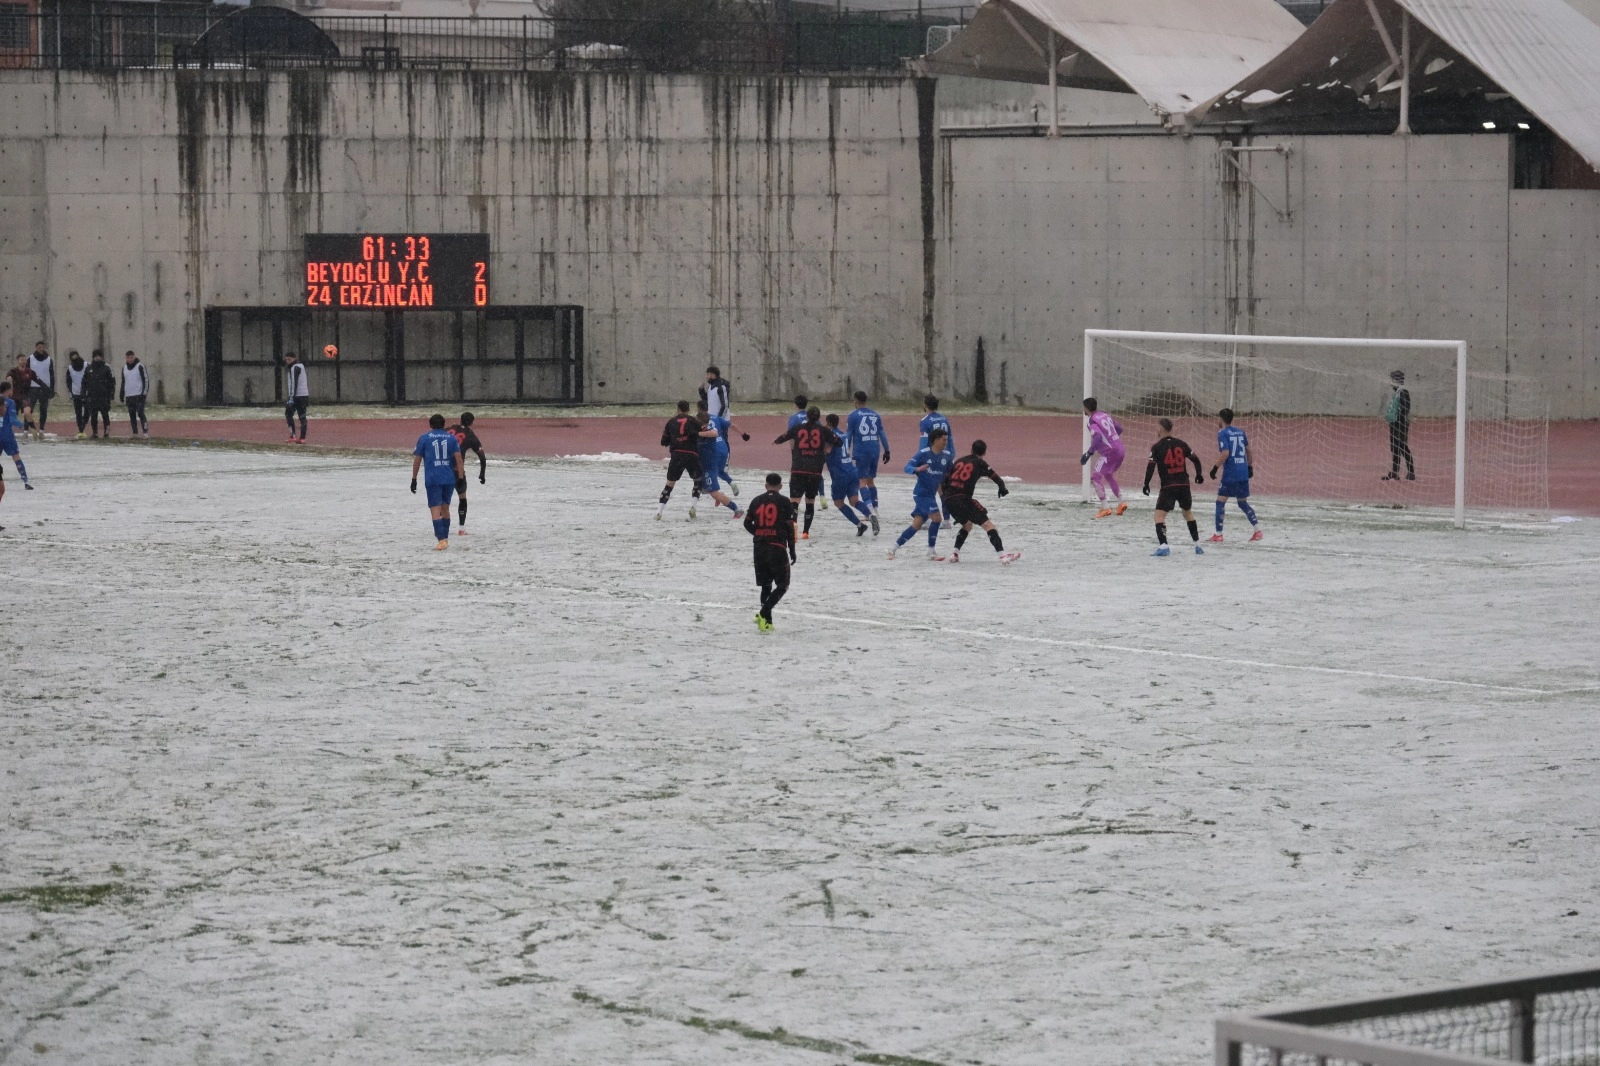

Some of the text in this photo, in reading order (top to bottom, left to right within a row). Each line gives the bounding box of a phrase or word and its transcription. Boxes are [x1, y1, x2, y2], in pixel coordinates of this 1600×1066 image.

[474, 262, 486, 282] 2
[307, 285, 332, 306] 24
[474, 284, 487, 306] 0
[677, 417, 688, 435] 7
[859, 416, 878, 435] 63
[797, 428, 821, 449] 23
[1229, 436, 1246, 457] 75
[431, 439, 448, 460] 11
[1164, 447, 1185, 467] 48
[951, 461, 974, 481] 28
[755, 503, 778, 527] 19
